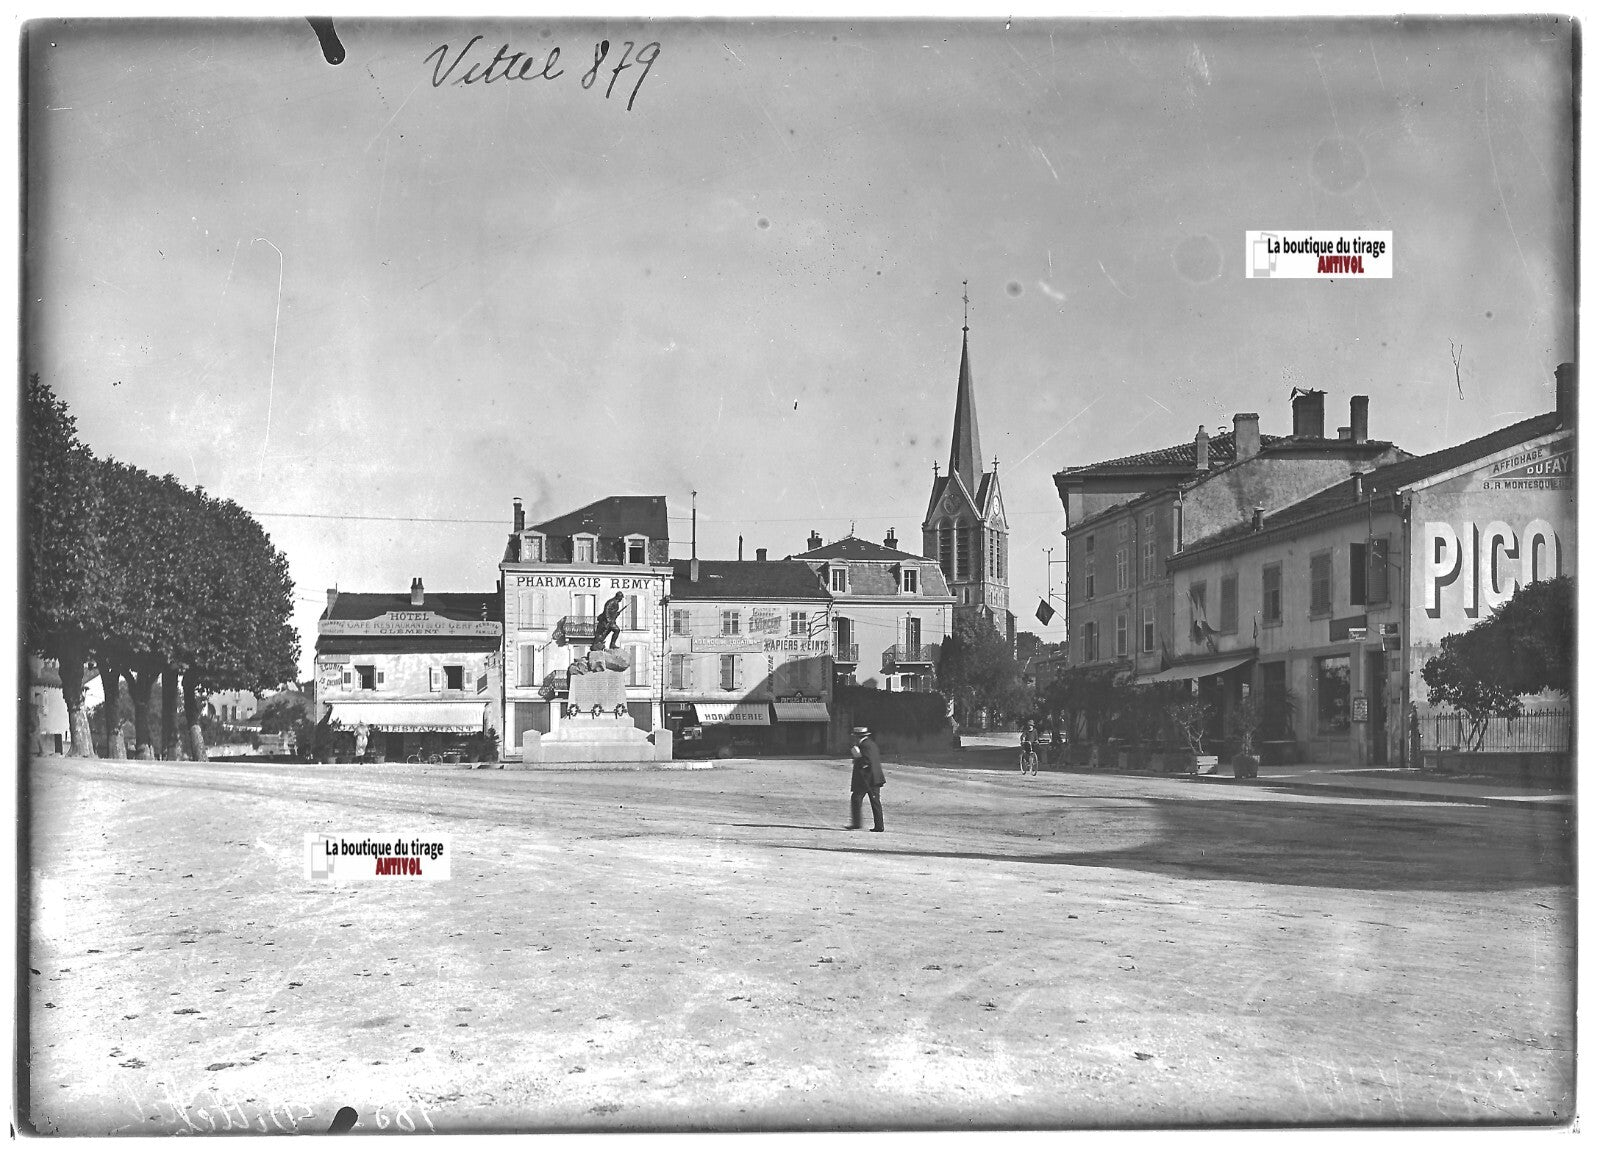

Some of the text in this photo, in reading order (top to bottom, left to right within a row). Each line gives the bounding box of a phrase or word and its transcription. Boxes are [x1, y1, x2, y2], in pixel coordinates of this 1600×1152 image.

[423, 35, 661, 111] Vittel 879
[1493, 449, 1543, 474] AFFICHAGE
[517, 576, 651, 589] PHARMACIE REMY
[704, 713, 764, 721] HORLOGERIE
